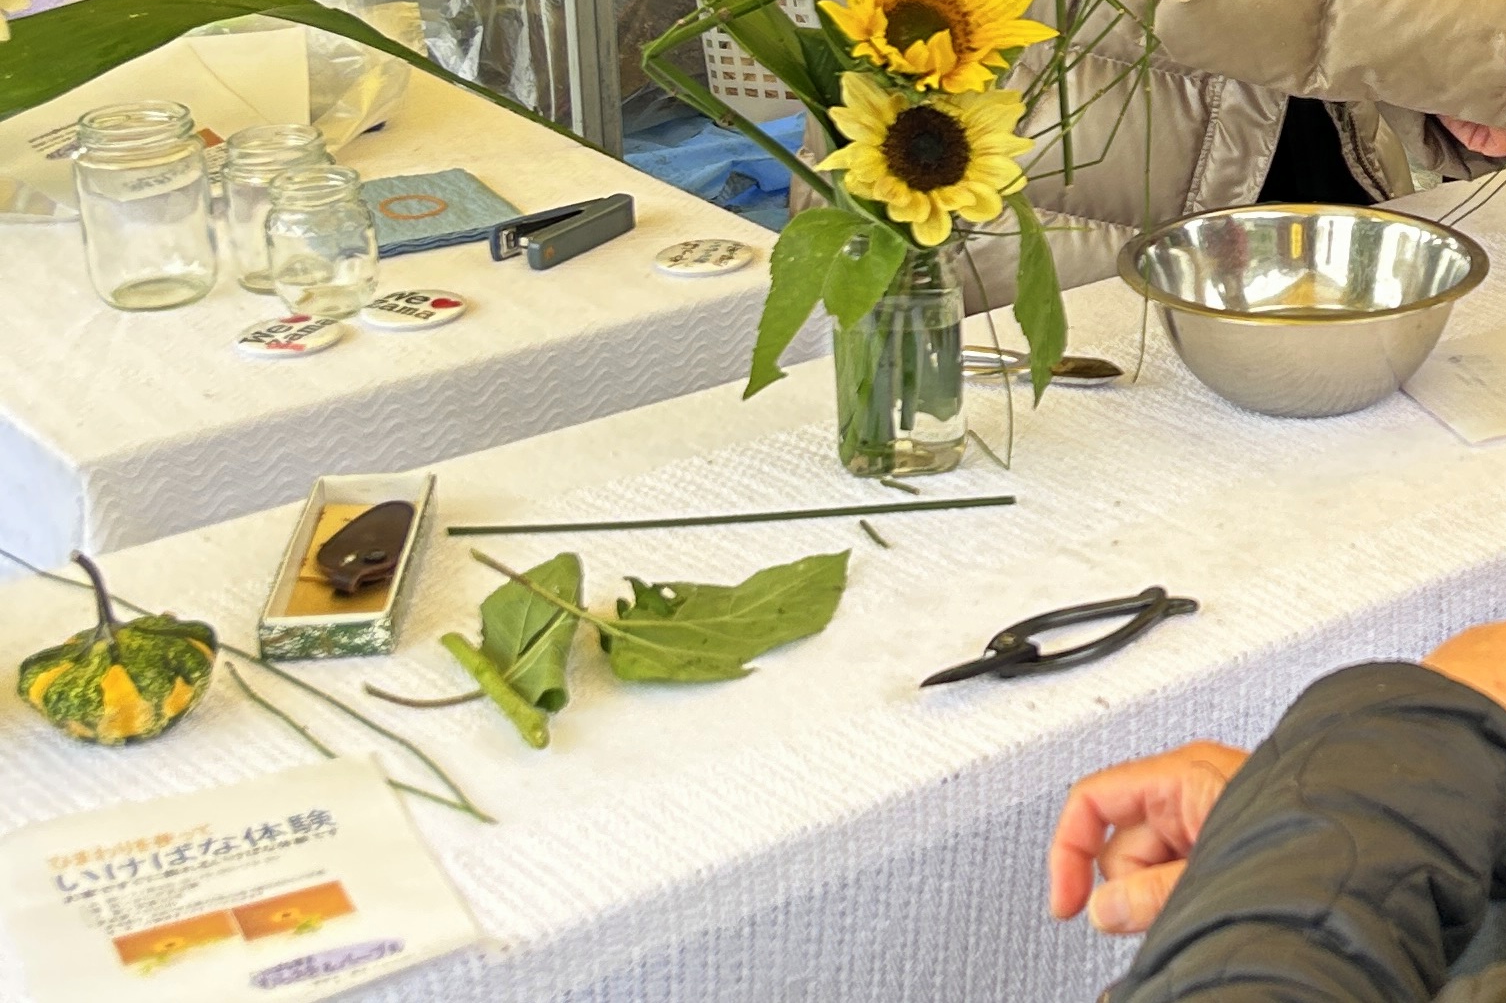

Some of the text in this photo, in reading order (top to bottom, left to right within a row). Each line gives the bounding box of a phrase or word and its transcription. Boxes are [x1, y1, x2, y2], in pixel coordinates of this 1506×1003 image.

[238, 323, 294, 344] We
[56, 808, 334, 892] いけばな体験
